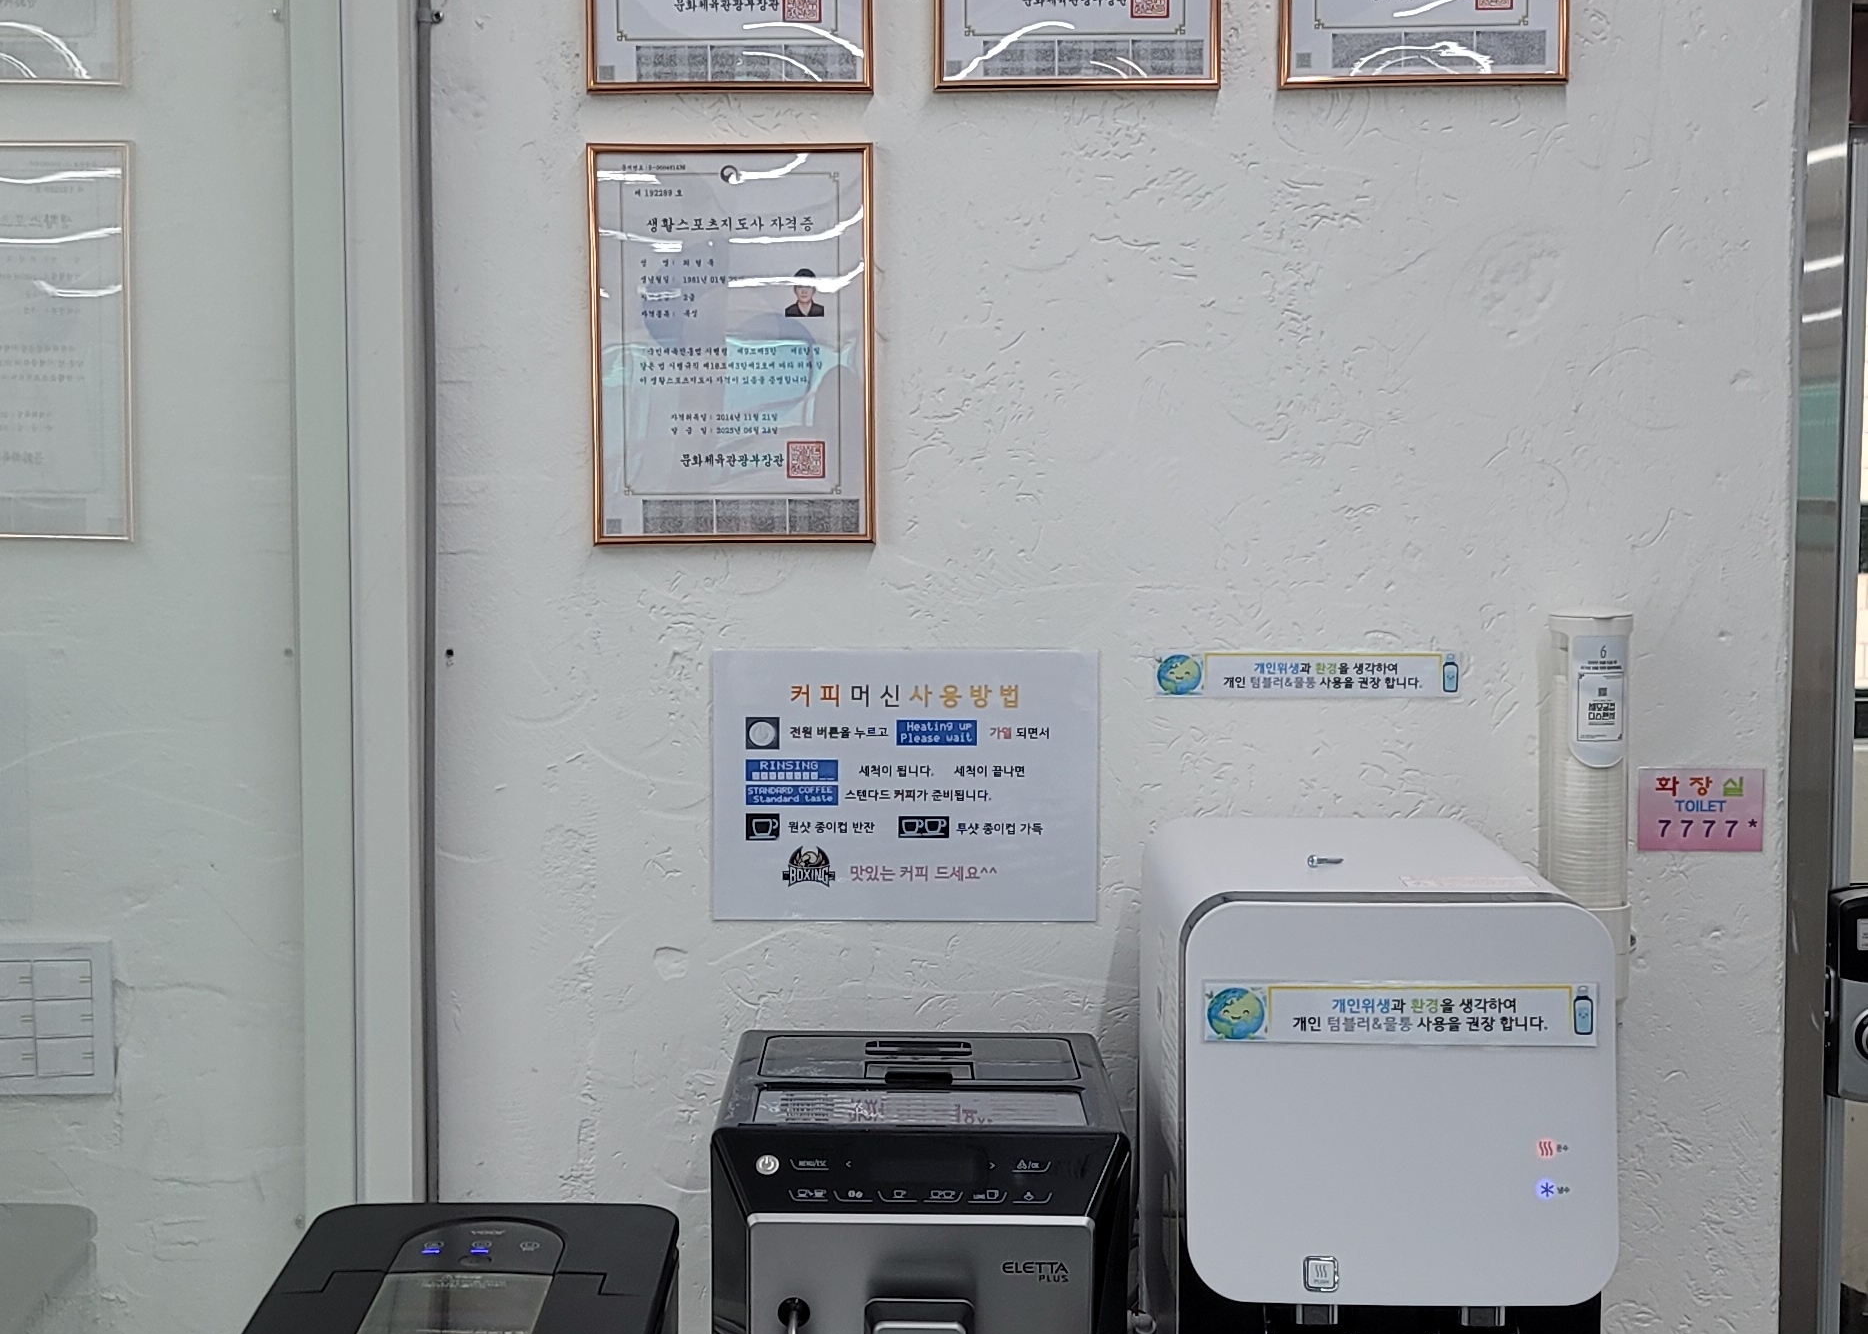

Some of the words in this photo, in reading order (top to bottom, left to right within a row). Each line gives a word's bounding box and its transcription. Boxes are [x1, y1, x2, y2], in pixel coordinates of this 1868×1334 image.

[646, 216, 765, 233] 생활스포츠지도사
[770, 215, 814, 233] 자격증
[1254, 662, 1312, 675] 개인위생과
[1352, 662, 1398, 675] 생각하여
[1223, 676, 1246, 689] 개인
[1319, 676, 1354, 689] 사용을
[1357, 676, 1381, 689] 권장
[789, 725, 813, 739] 전원
[816, 725, 852, 740] 버튼을
[853, 725, 889, 740] 누르고
[906, 720, 954, 733] Heating
[957, 722, 973, 732] up
[989, 726, 1013, 740] 가열
[1016, 726, 1051, 740] 되면서
[900, 732, 941, 744] Please
[945, 732, 973, 743] wait
[758, 760, 819, 771] RINSING
[858, 764, 893, 778] 세척이
[953, 764, 989, 778] 세척이
[991, 764, 1026, 778] 끝나면
[746, 786, 794, 795] STANDARD
[797, 786, 834, 794] COFFEE
[844, 788, 891, 802] 스텐다드
[893, 788, 929, 802] 커피가
[931, 788, 992, 802] 준비됩니다.
[753, 794, 800, 804] Standard
[811, 793, 834, 803] taste
[1674, 799, 1727, 813] TOILET
[787, 820, 812, 835] 원샷
[814, 820, 849, 835] 종이컵
[851, 821, 876, 834] 반잔
[955, 821, 979, 836] 투샷
[981, 822, 1016, 836] 종이컵
[1019, 821, 1044, 836] 가득
[789, 866, 830, 884] BOXING
[849, 865, 896, 882] 맛있는
[899, 865, 929, 882] 커피
[1331, 998, 1406, 1014] 개인위생과
[1410, 997, 1455, 1014] 환경을
[1458, 998, 1518, 1014] 생각하여
[1292, 1016, 1322, 1032] 개인
[1417, 1016, 1461, 1032] 사용을
[1465, 1016, 1495, 1032] 권장
[1002, 1261, 1069, 1274] ELETTA
[1038, 1274, 1069, 1283] PLUS
